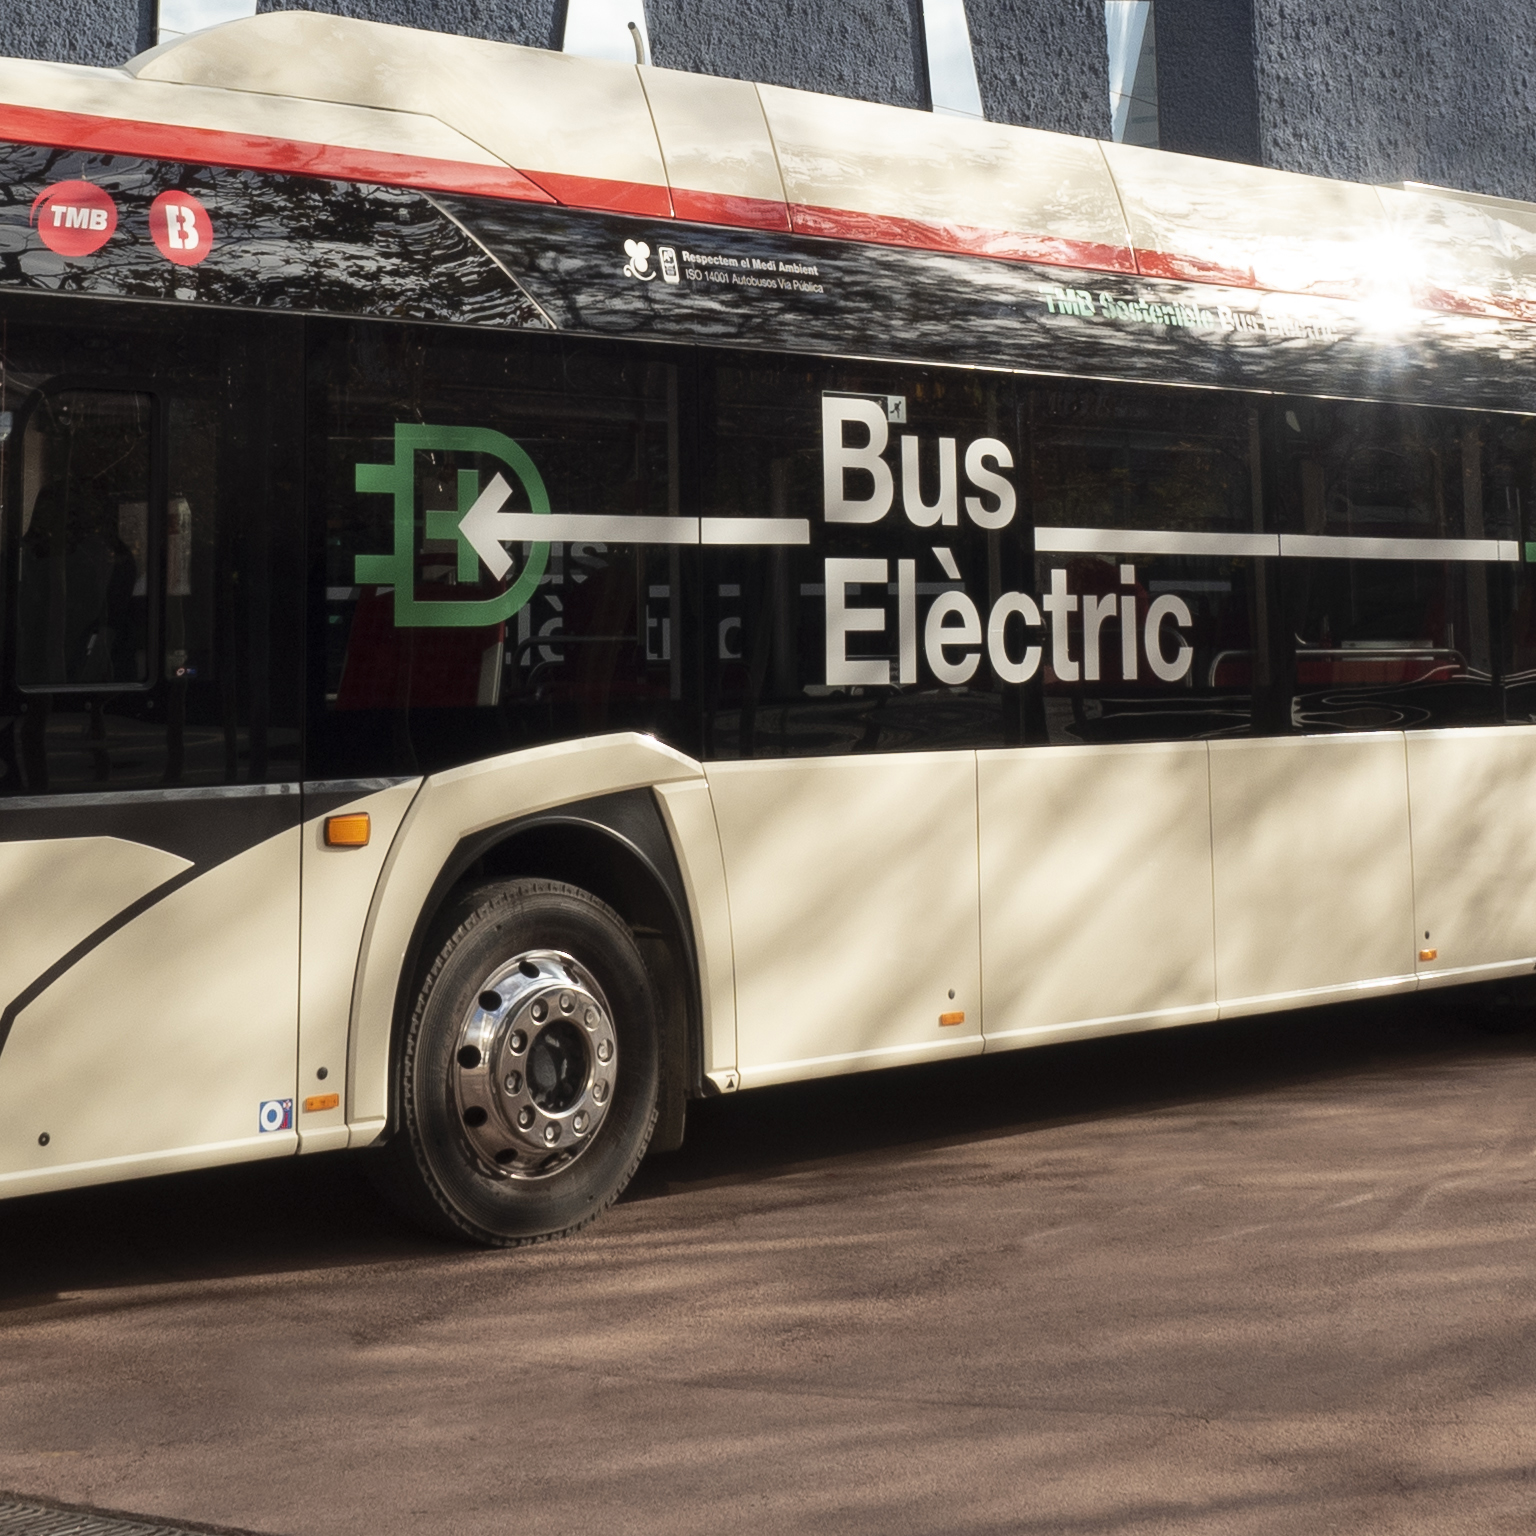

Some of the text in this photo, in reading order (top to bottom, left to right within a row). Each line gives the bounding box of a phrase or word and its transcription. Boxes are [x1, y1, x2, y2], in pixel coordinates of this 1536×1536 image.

[50, 204, 109, 231] TMB
[165, 204, 200, 250] B
[681, 250, 819, 276] Respectem el Medi Ambient
[685, 268, 703, 281] ISO
[704, 270, 730, 284] 14001
[731, 273, 777, 289] Autobusos
[792, 279, 824, 294] Pública
[1037, 286, 1095, 317] TMB
[821, 396, 1017, 529] Bus
[824, 547, 1194, 686] Elèctric
